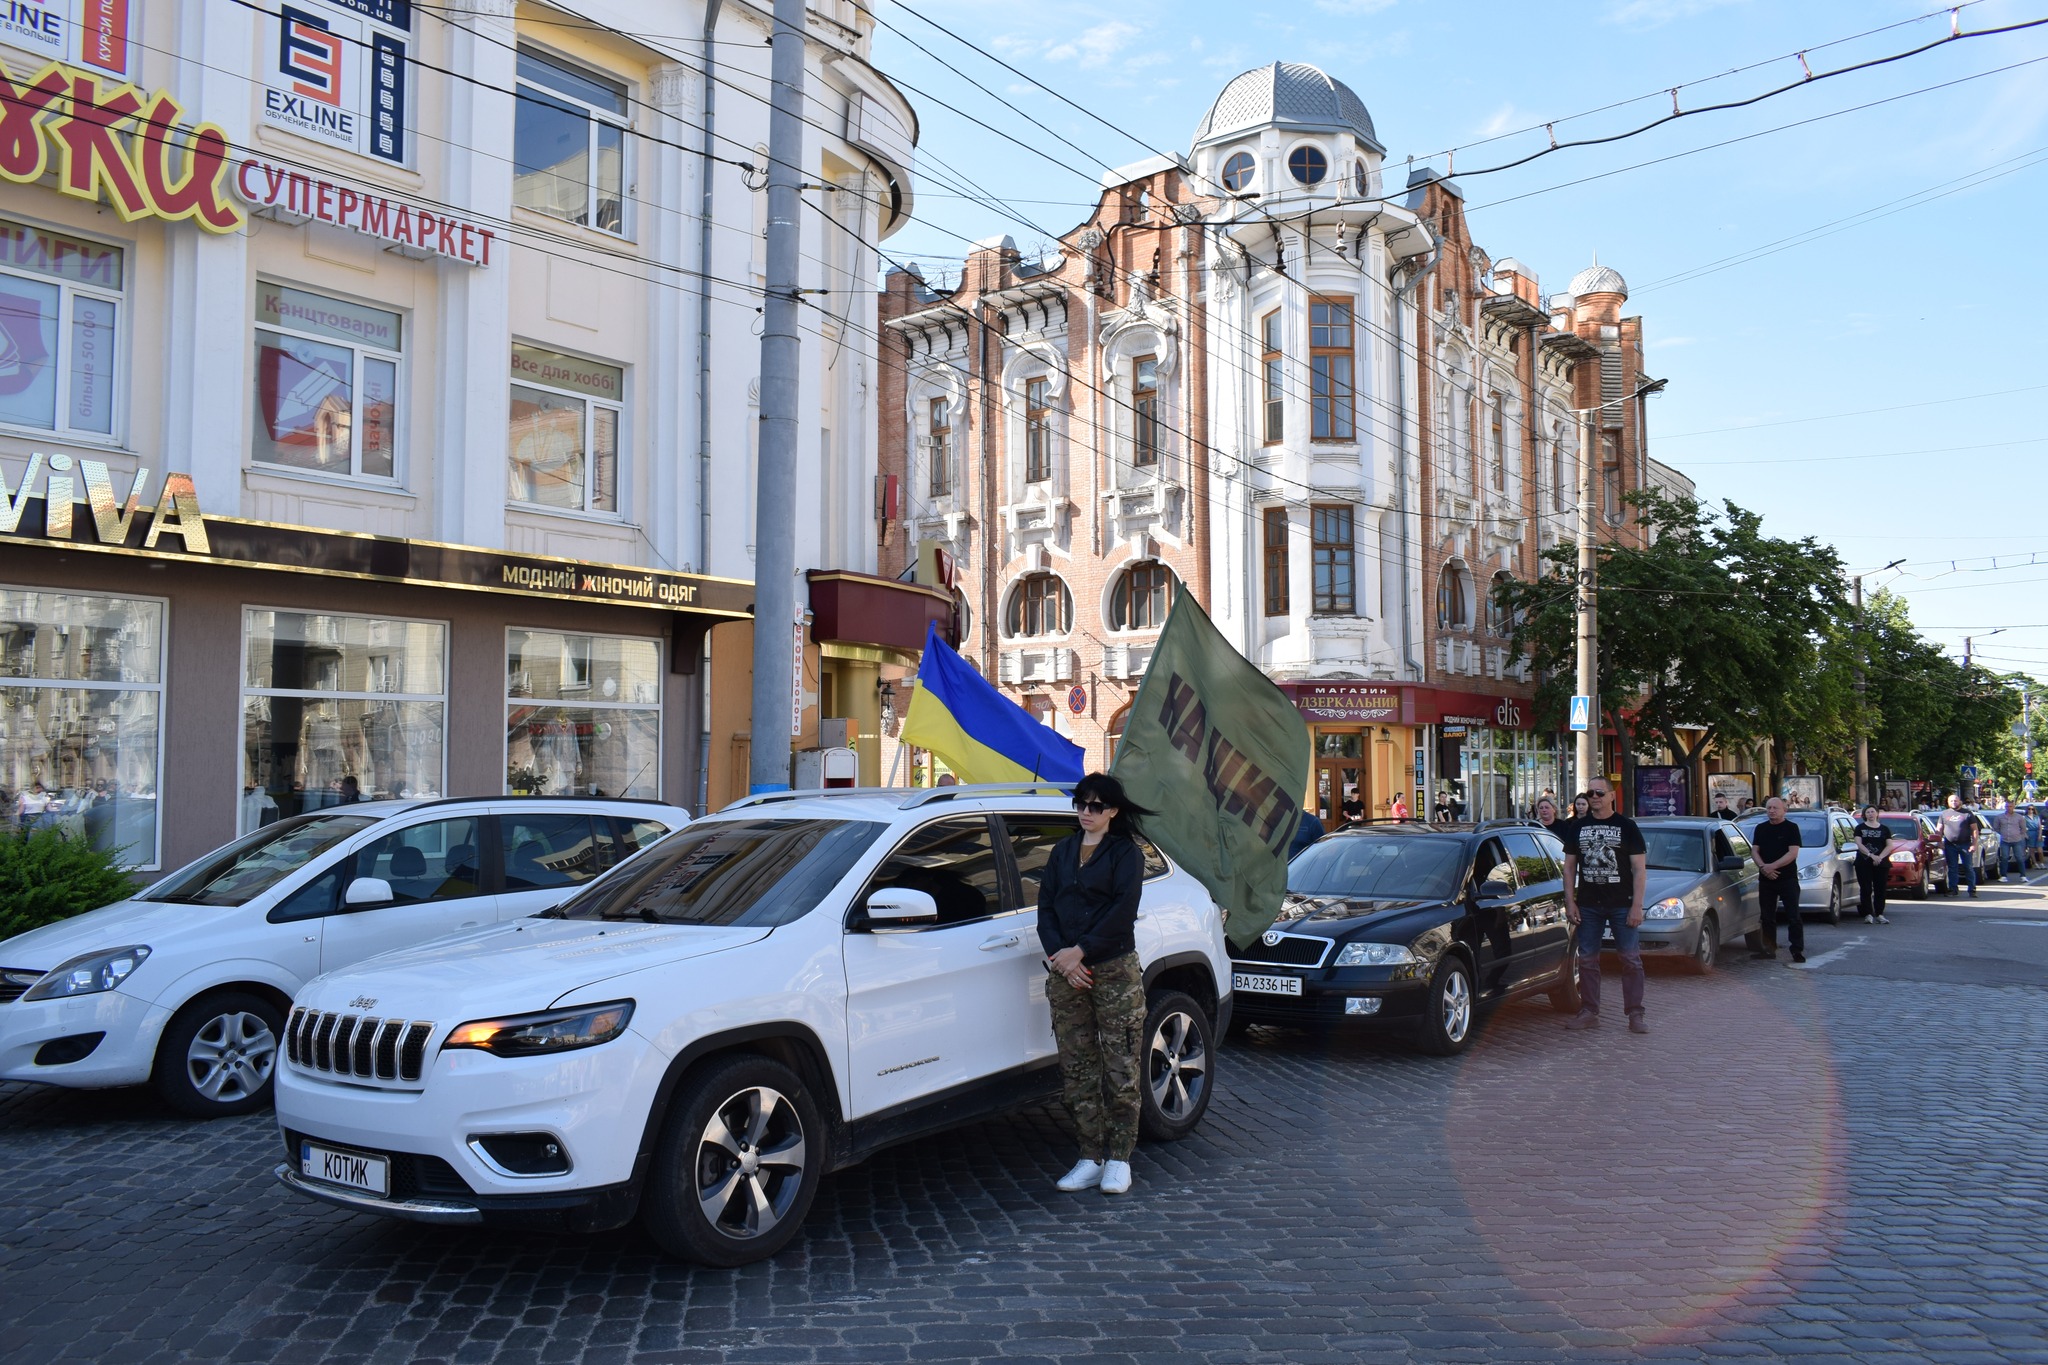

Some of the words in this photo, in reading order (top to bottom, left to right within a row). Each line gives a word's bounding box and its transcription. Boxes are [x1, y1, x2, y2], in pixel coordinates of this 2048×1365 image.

[15, 25, 61, 47] ПОЛЬШЕ
[97, 15, 114, 62] КУРСИ
[265, 109, 309, 129] ОБУЧЕНИЕ
[311, 124, 317, 132] В
[319, 127, 353, 144] ПОЛЬШЕ
[266, 88, 353, 135] EXLINE
[237, 158, 495, 267] СУПЕРМАРКЕТ
[83, 311, 96, 339] 000
[264, 294, 389, 338] Канцтовари
[82, 342, 95, 360] 50
[511, 354, 538, 373] Все
[541, 365, 570, 380] для
[574, 372, 615, 391] хоббі
[79, 364, 95, 417] більше
[503, 565, 576, 590] МОДНИЙ
[582, 574, 653, 598] ЖІНОЧИЙ
[659, 584, 697, 604] ОДЯГ
[1300, 695, 1399, 709] ДЗЕРКАЛЬНИЙ
[1315, 687, 1387, 695] МАГАЗИН
[1158, 671, 1207, 764] НА
[1497, 697, 1520, 727] elis
[1235, 975, 1251, 989] BA
[1253, 978, 1278, 991] 2336
[1280, 979, 1297, 993] HE
[349, 994, 379, 1011] Jeep
[324, 1152, 369, 1186] КОТИК
